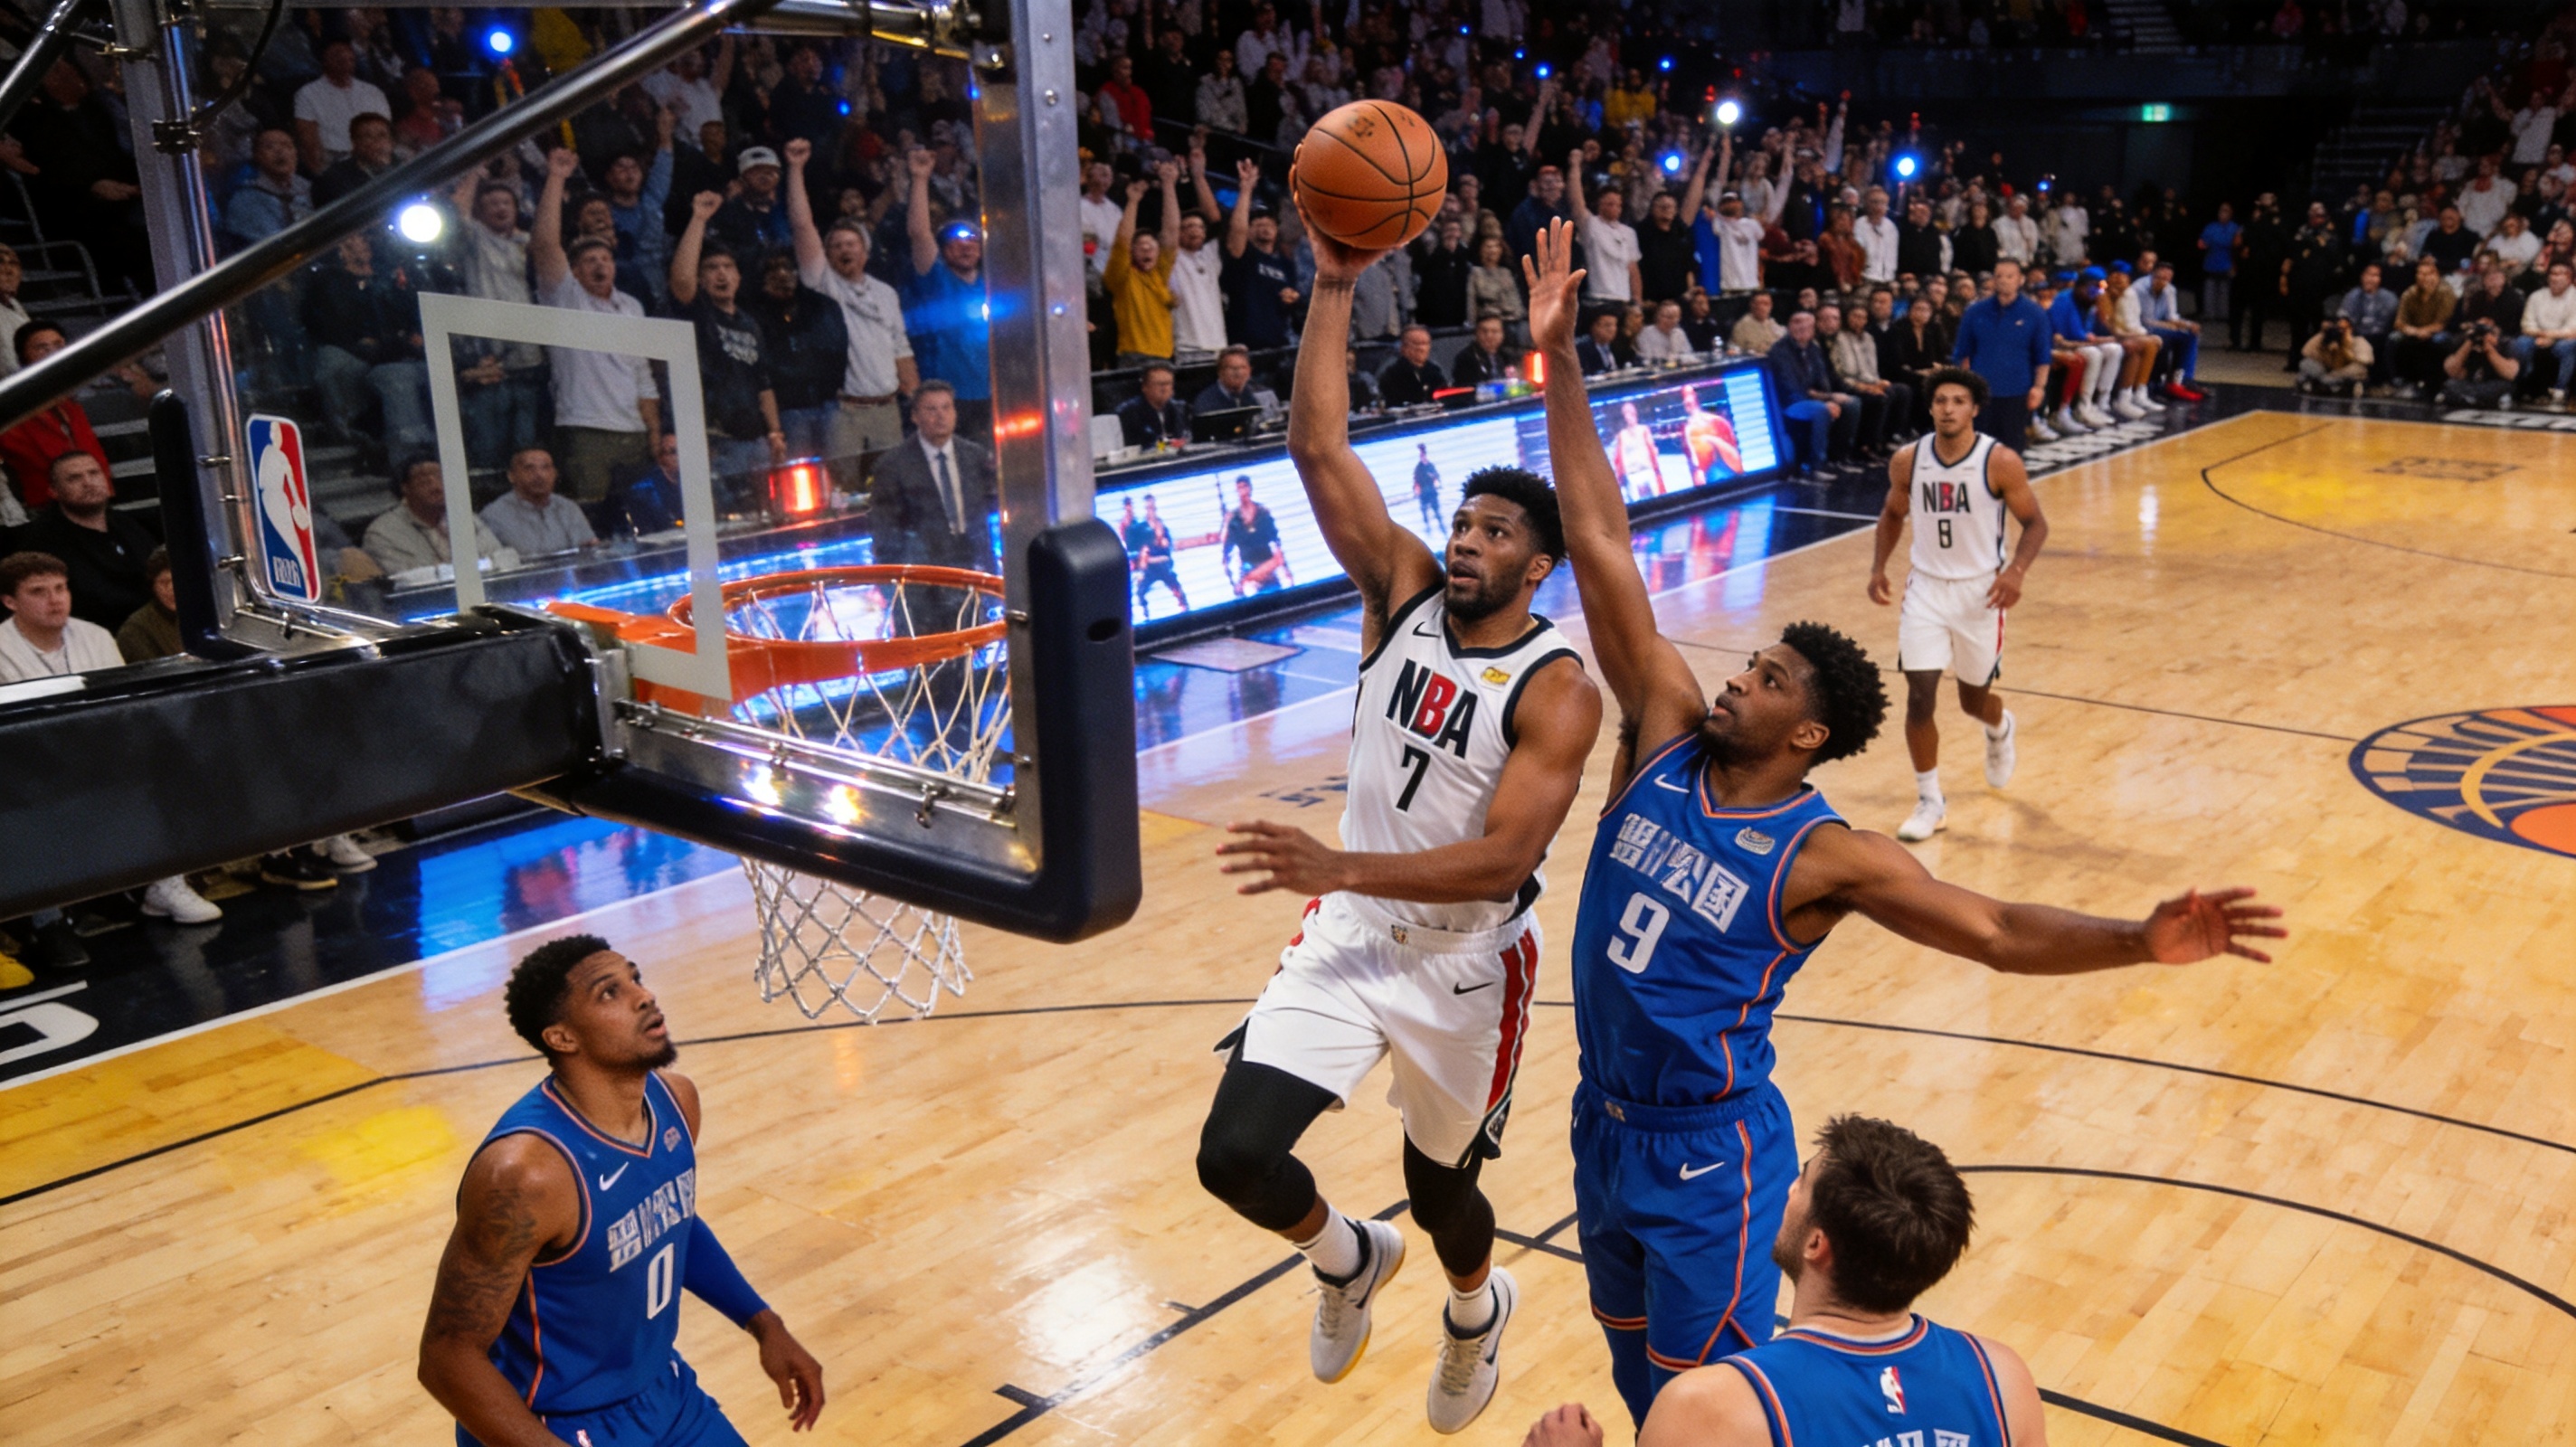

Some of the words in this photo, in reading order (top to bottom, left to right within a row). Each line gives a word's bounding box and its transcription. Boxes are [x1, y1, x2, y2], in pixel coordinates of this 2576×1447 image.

[1922, 481, 1971, 514] NBA
[1386, 657, 1478, 760] NBA
[1396, 743, 1431, 812] 7
[1606, 892, 1670, 975] 9
[647, 1243, 675, 1320] 0
